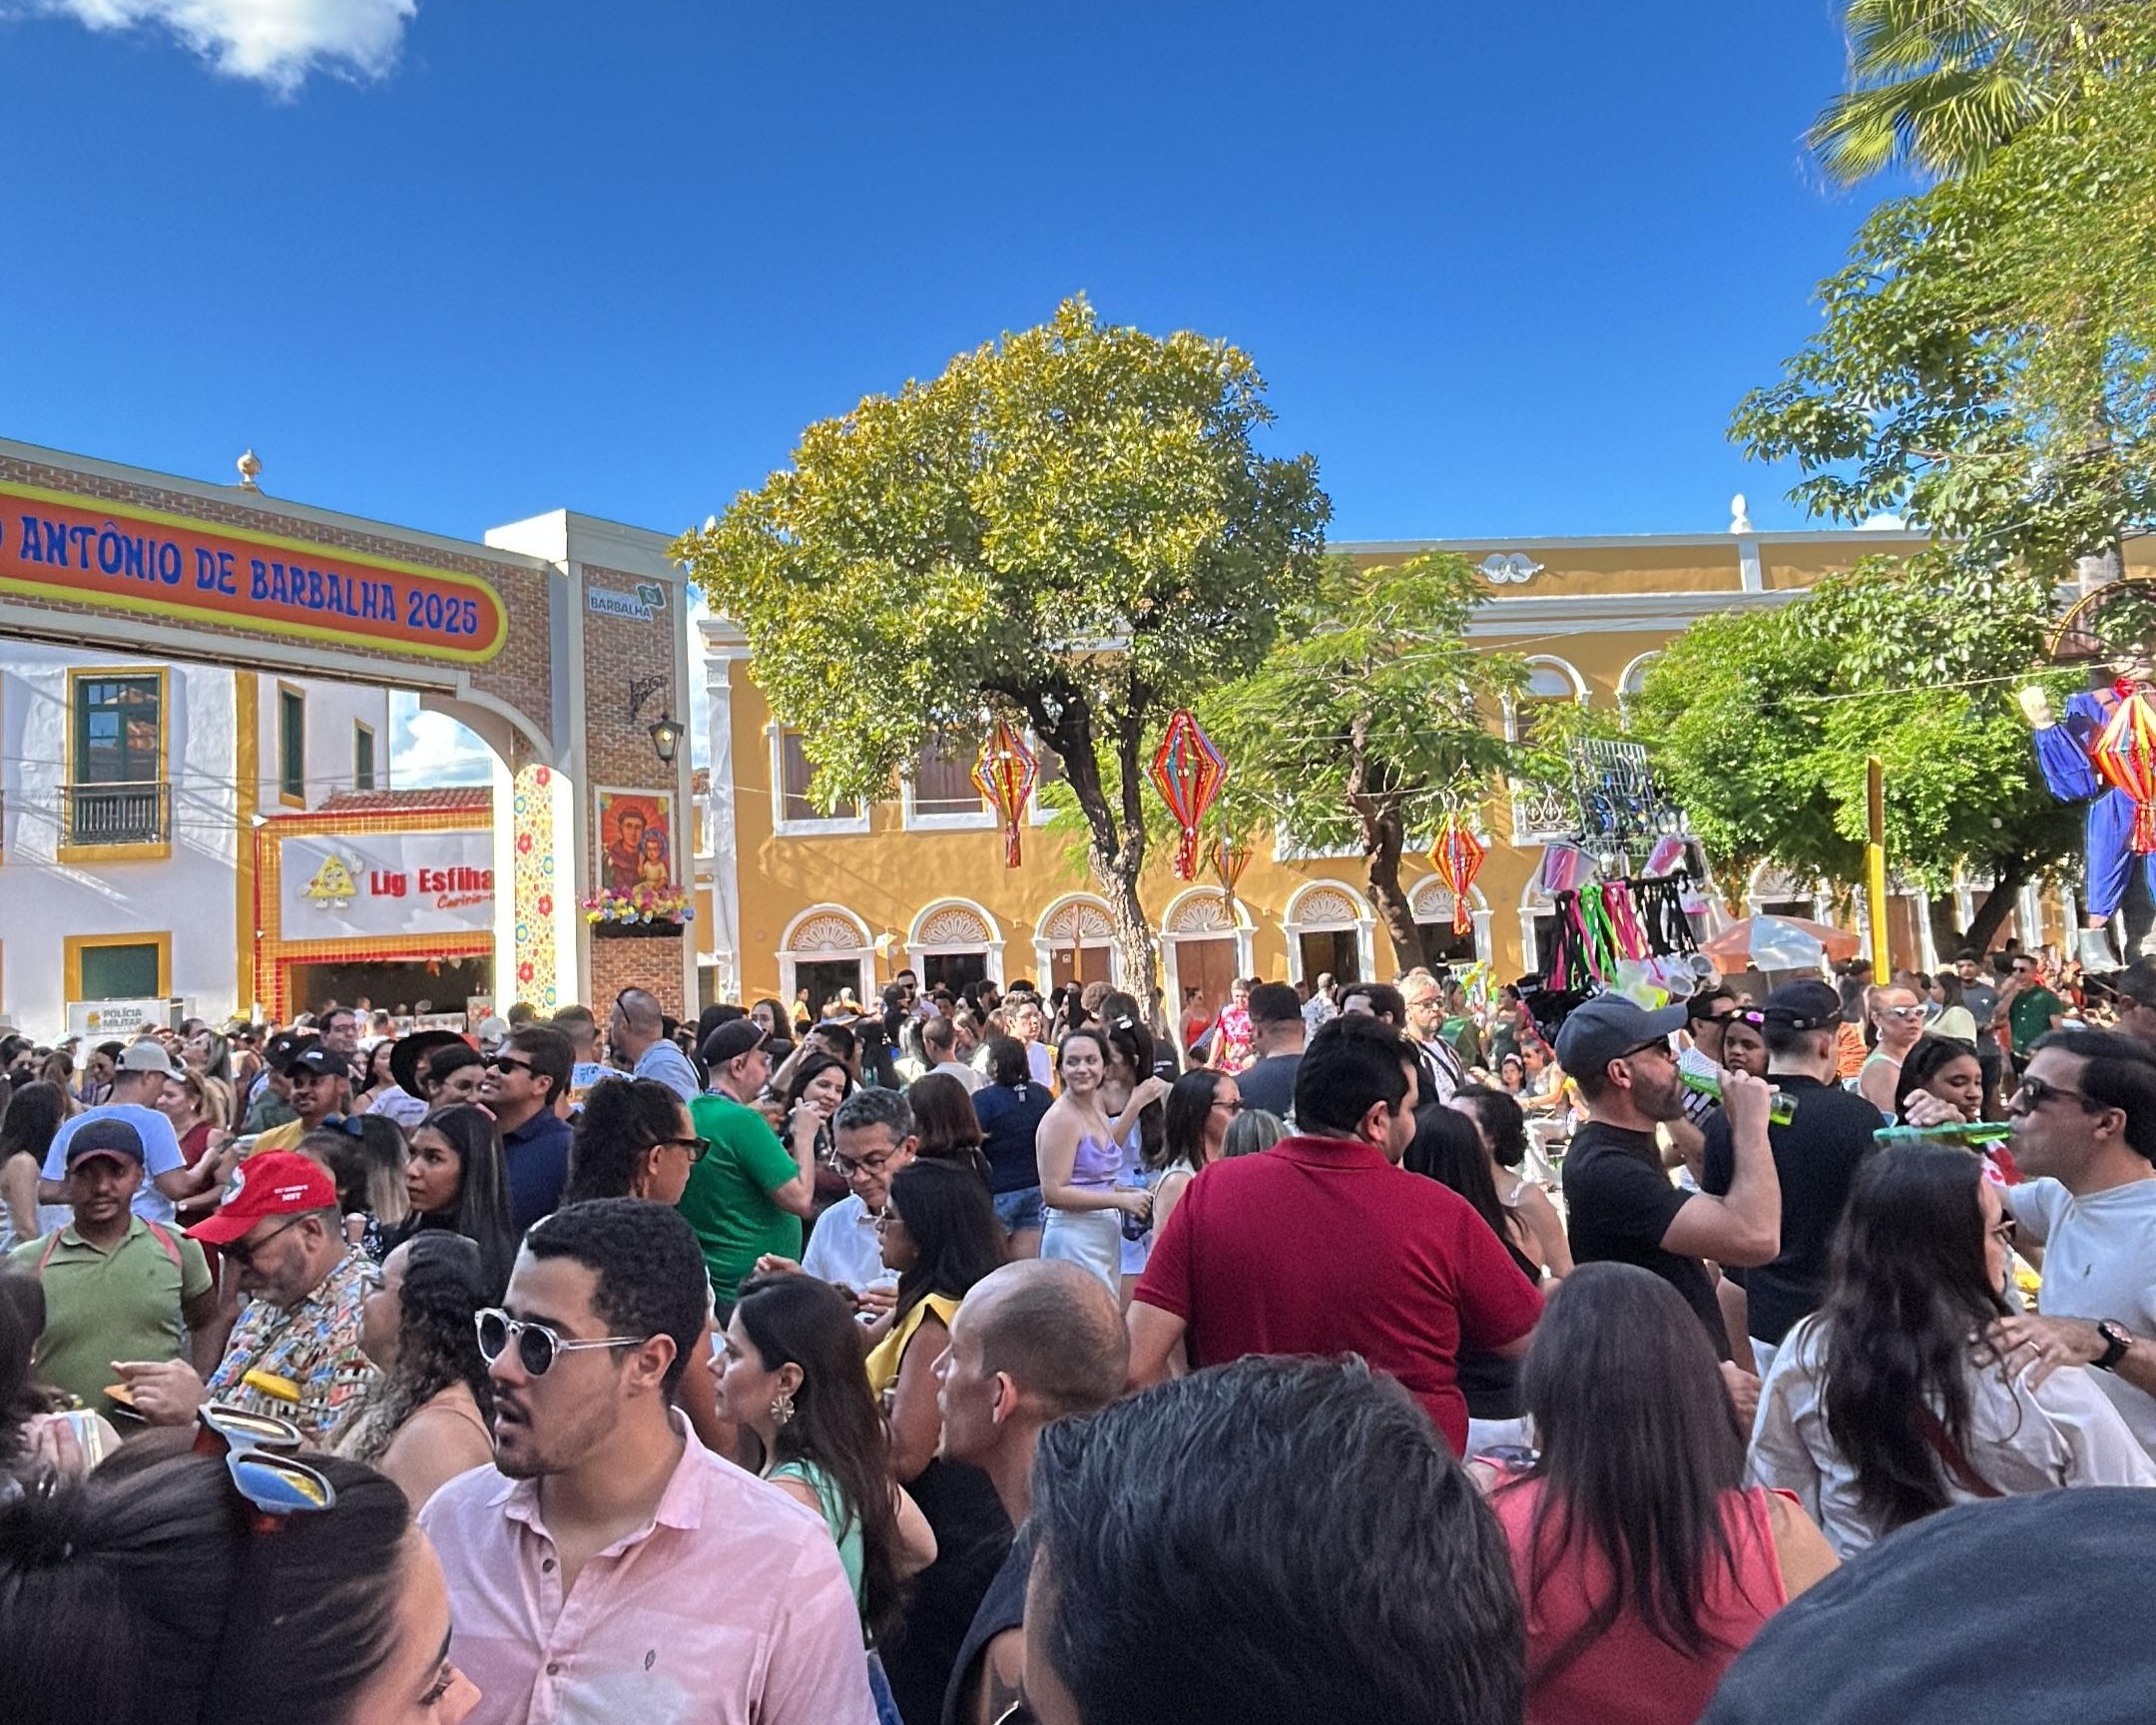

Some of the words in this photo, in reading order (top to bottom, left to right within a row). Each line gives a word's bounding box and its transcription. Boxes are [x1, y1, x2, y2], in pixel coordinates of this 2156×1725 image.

[20, 515, 183, 586] ANTÔNIO
[195, 547, 238, 595] DE
[251, 559, 397, 622] BARBALHA
[407, 590, 479, 635] 2025
[590, 597, 651, 618] BARBALHA
[370, 870, 407, 897] Lig
[103, 1006, 143, 1018] POLÍCIA
